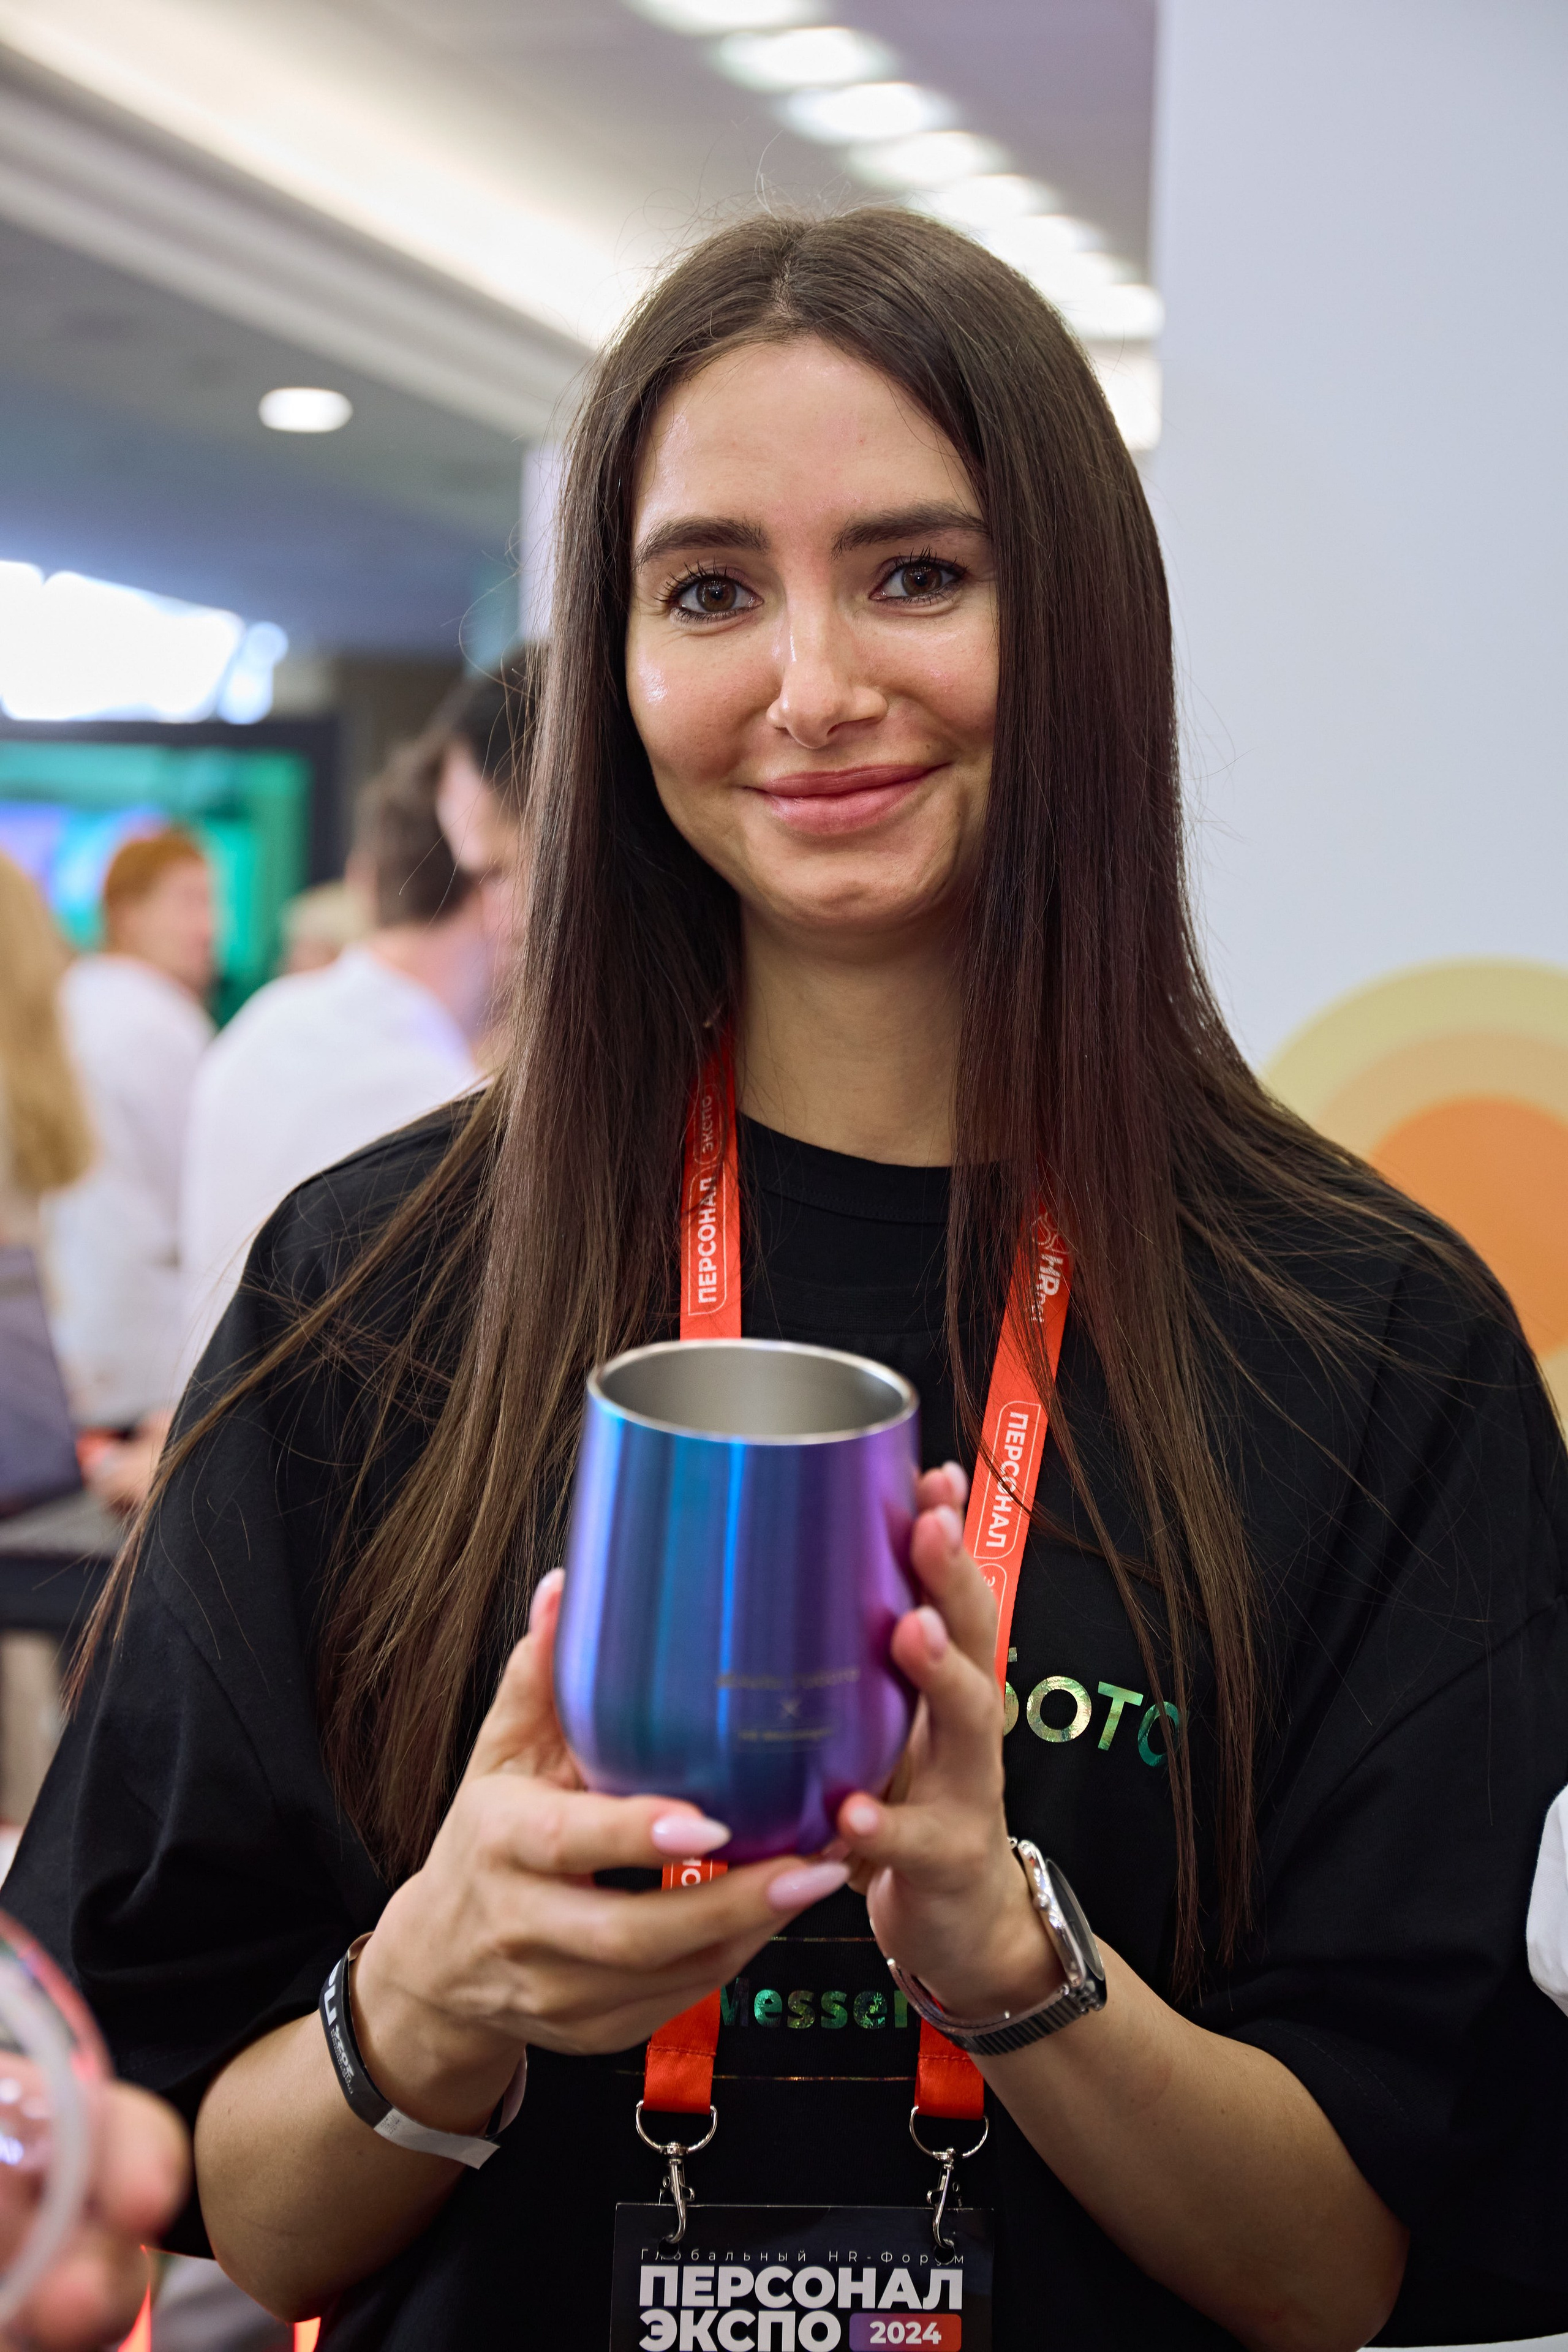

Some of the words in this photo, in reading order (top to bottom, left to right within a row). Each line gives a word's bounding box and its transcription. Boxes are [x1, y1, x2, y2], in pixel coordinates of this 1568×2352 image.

[698, 1177, 717, 1304] ПЕРСОНАЛ
[986, 1411, 1029, 1548] ПЕРСОНАЛ
[828, 2250, 964, 2266] HR-Форм
[639, 2264, 963, 2309] ПЕРСОНАЛ
[639, 2309, 842, 2352] ЭКСПО
[870, 2321, 941, 2345] 2024
